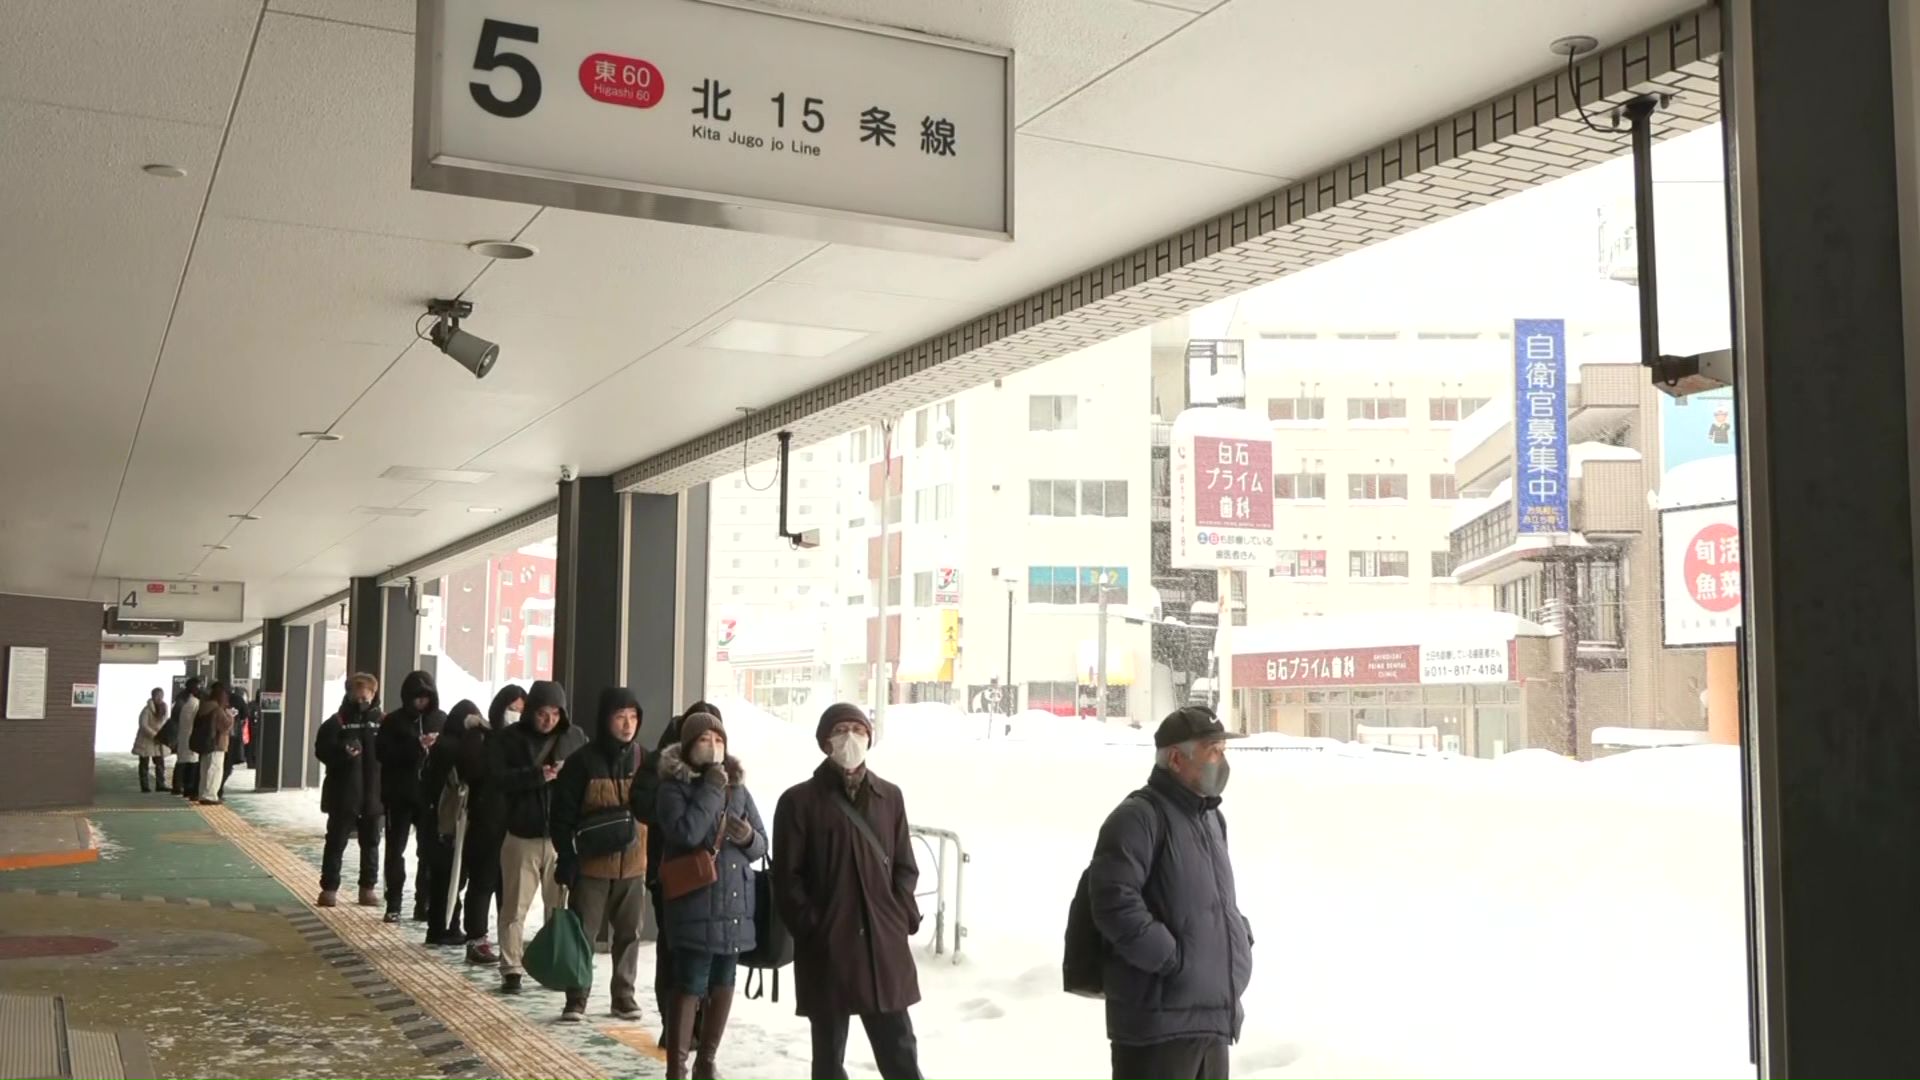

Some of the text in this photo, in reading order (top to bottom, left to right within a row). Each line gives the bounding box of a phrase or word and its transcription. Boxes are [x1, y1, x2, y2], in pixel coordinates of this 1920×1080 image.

[468, 18, 543, 119] 5
[593, 59, 651, 88] 東 60
[594, 83, 650, 102] Higashi 60
[691, 125, 821, 156] Kita Jugo jo Line
[1526, 333, 1559, 503] 自衛官募集中
[1218, 441, 1249, 466] 白石
[1205, 467, 1263, 493] プライム
[1219, 496, 1250, 519] 歯科
[122, 589, 138, 608] 4
[1266, 655, 1355, 681] 白石プライム歯科
